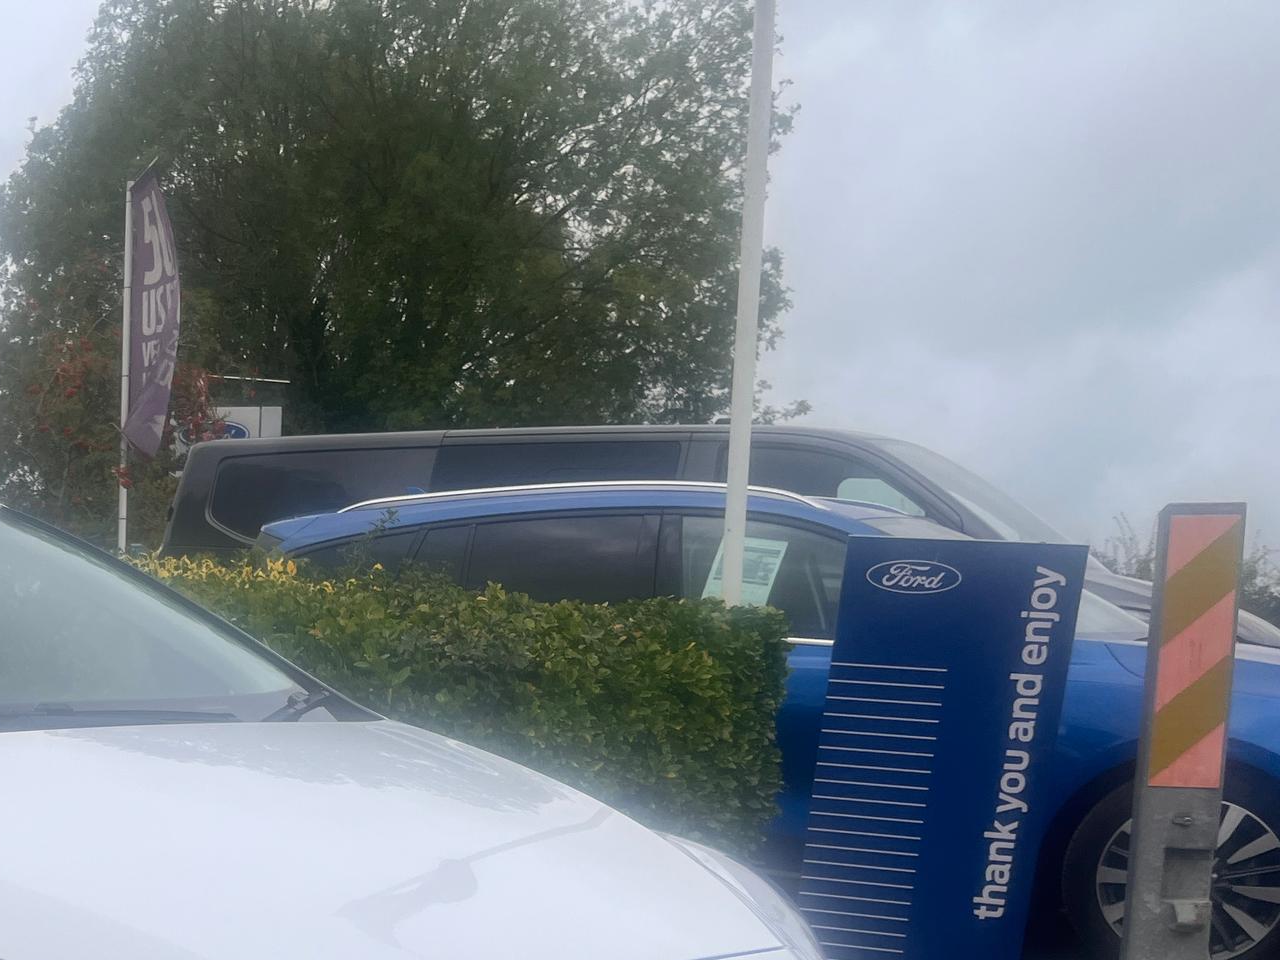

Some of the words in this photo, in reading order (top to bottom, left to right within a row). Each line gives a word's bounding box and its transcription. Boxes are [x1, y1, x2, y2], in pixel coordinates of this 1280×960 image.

[882, 563, 946, 589] Ford
[1020, 565, 1067, 666] enjoy
[1008, 672, 1044, 743] and
[995, 748, 1031, 814] you
[972, 820, 1020, 920] thank
